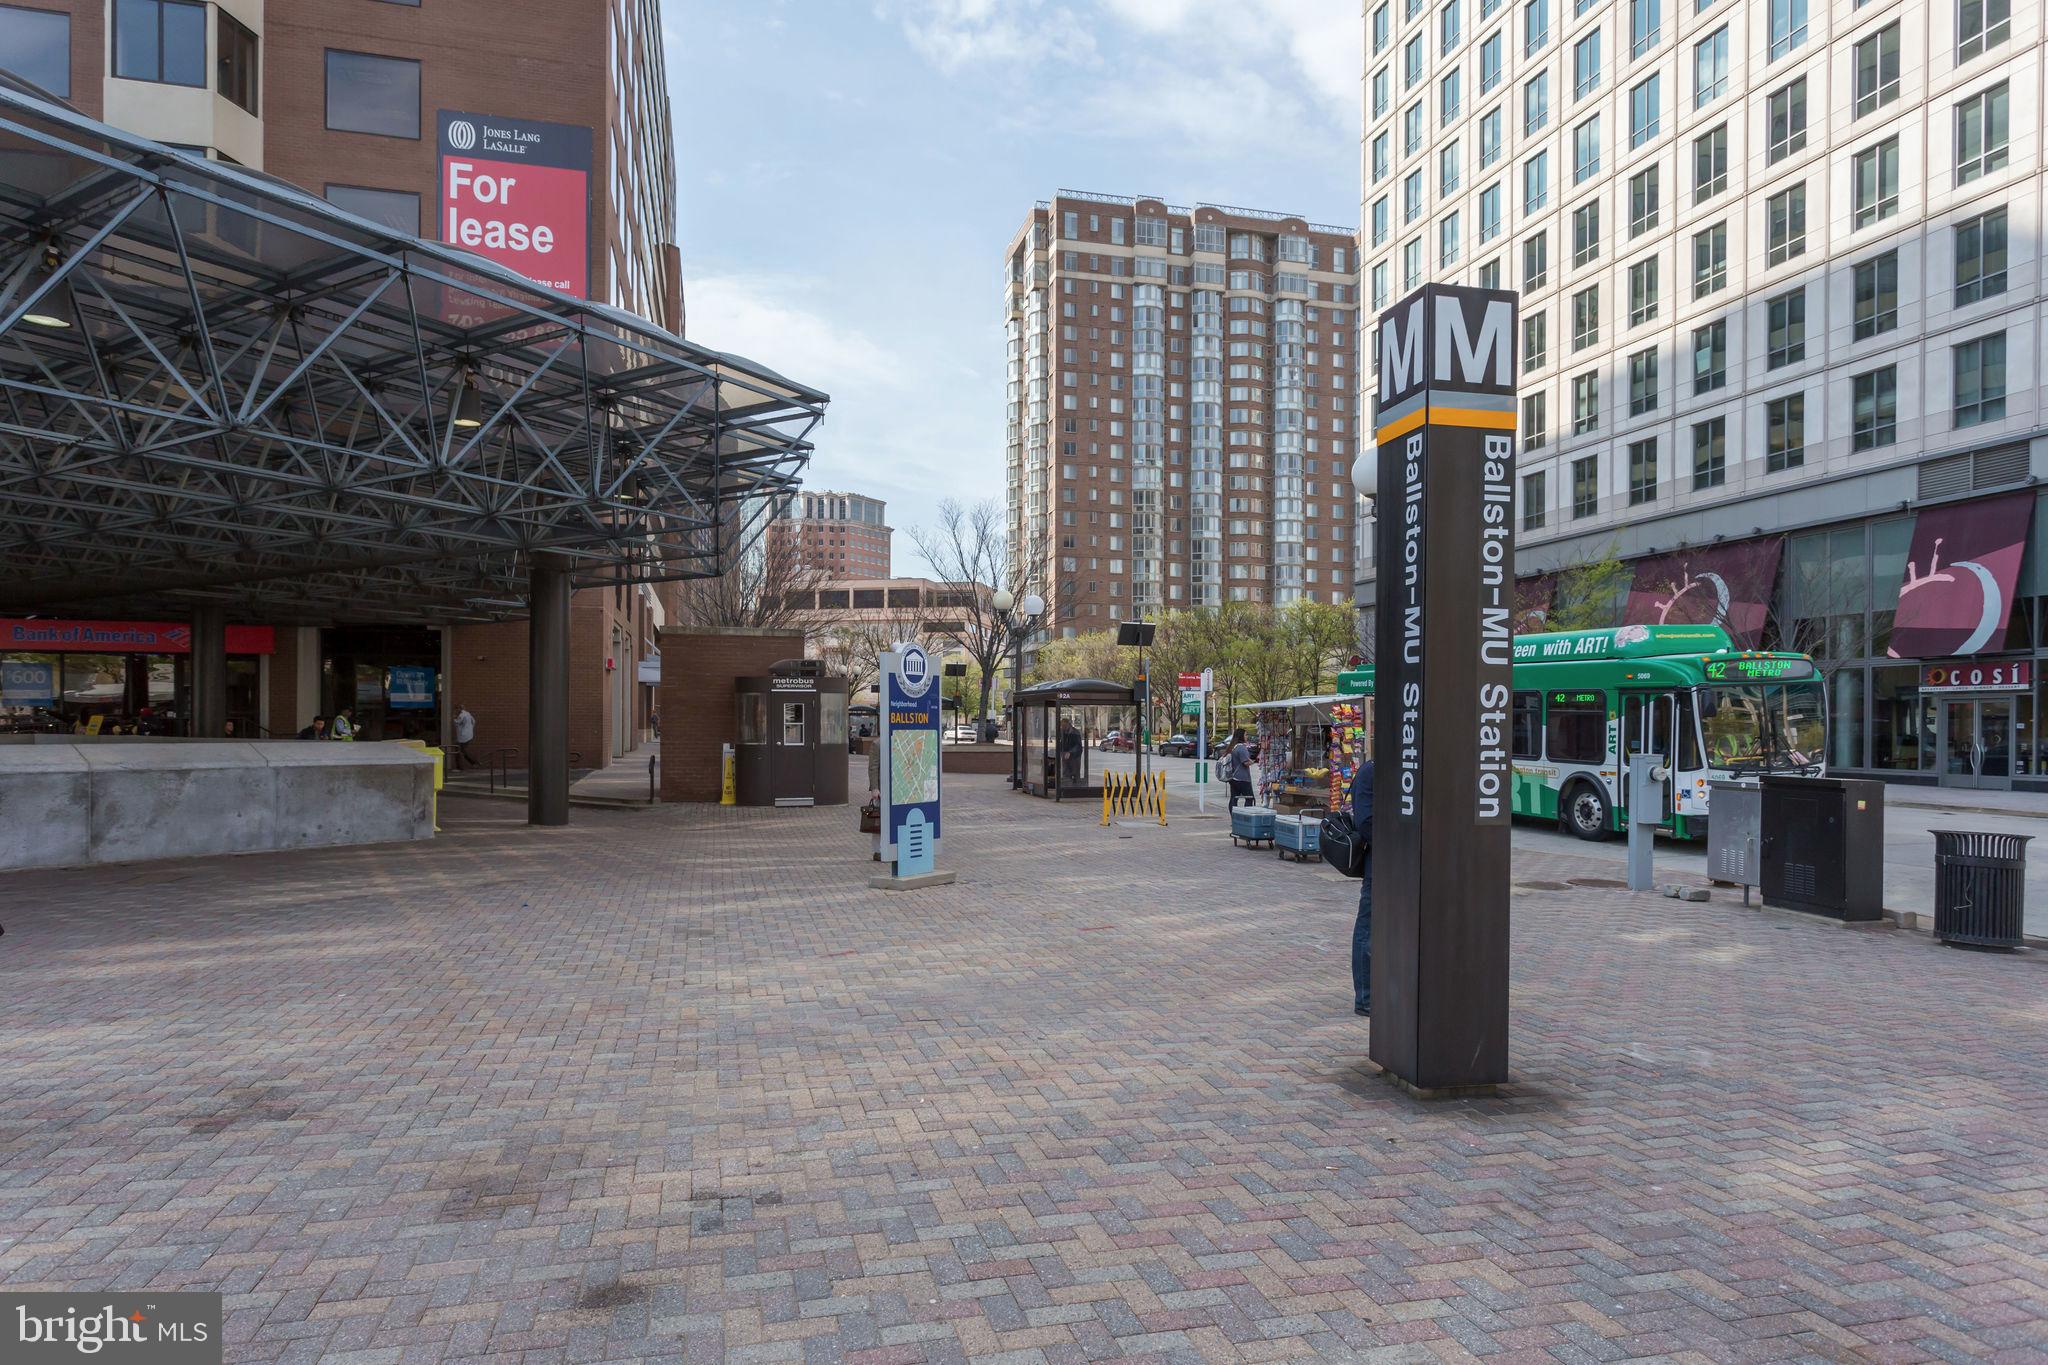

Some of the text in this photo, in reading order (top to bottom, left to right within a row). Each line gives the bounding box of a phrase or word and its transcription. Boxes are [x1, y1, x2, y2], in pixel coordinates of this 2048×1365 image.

[483, 125, 541, 143] JONES LANG
[450, 162, 516, 204] For
[450, 207, 554, 253] lease
[554, 280, 570, 289] call
[1381, 296, 1424, 403] M
[1435, 295, 1512, 386] M
[13, 624, 157, 644] Bank of America
[1401, 432, 1423, 816] Ballston-MU Station
[1479, 434, 1512, 818] Ballston-MU Station
[1513, 636, 1609, 657] een with ART!
[1707, 660, 1792, 679] 42 BALLSTON
[1747, 669, 1782, 677] METRO
[890, 700, 918, 708] Neighborhood
[1555, 694, 1595, 702] 42 METRO
[890, 712, 929, 724] BALLSTON
[1608, 725, 1617, 755] ART
[1535, 767, 1557, 776] transit
